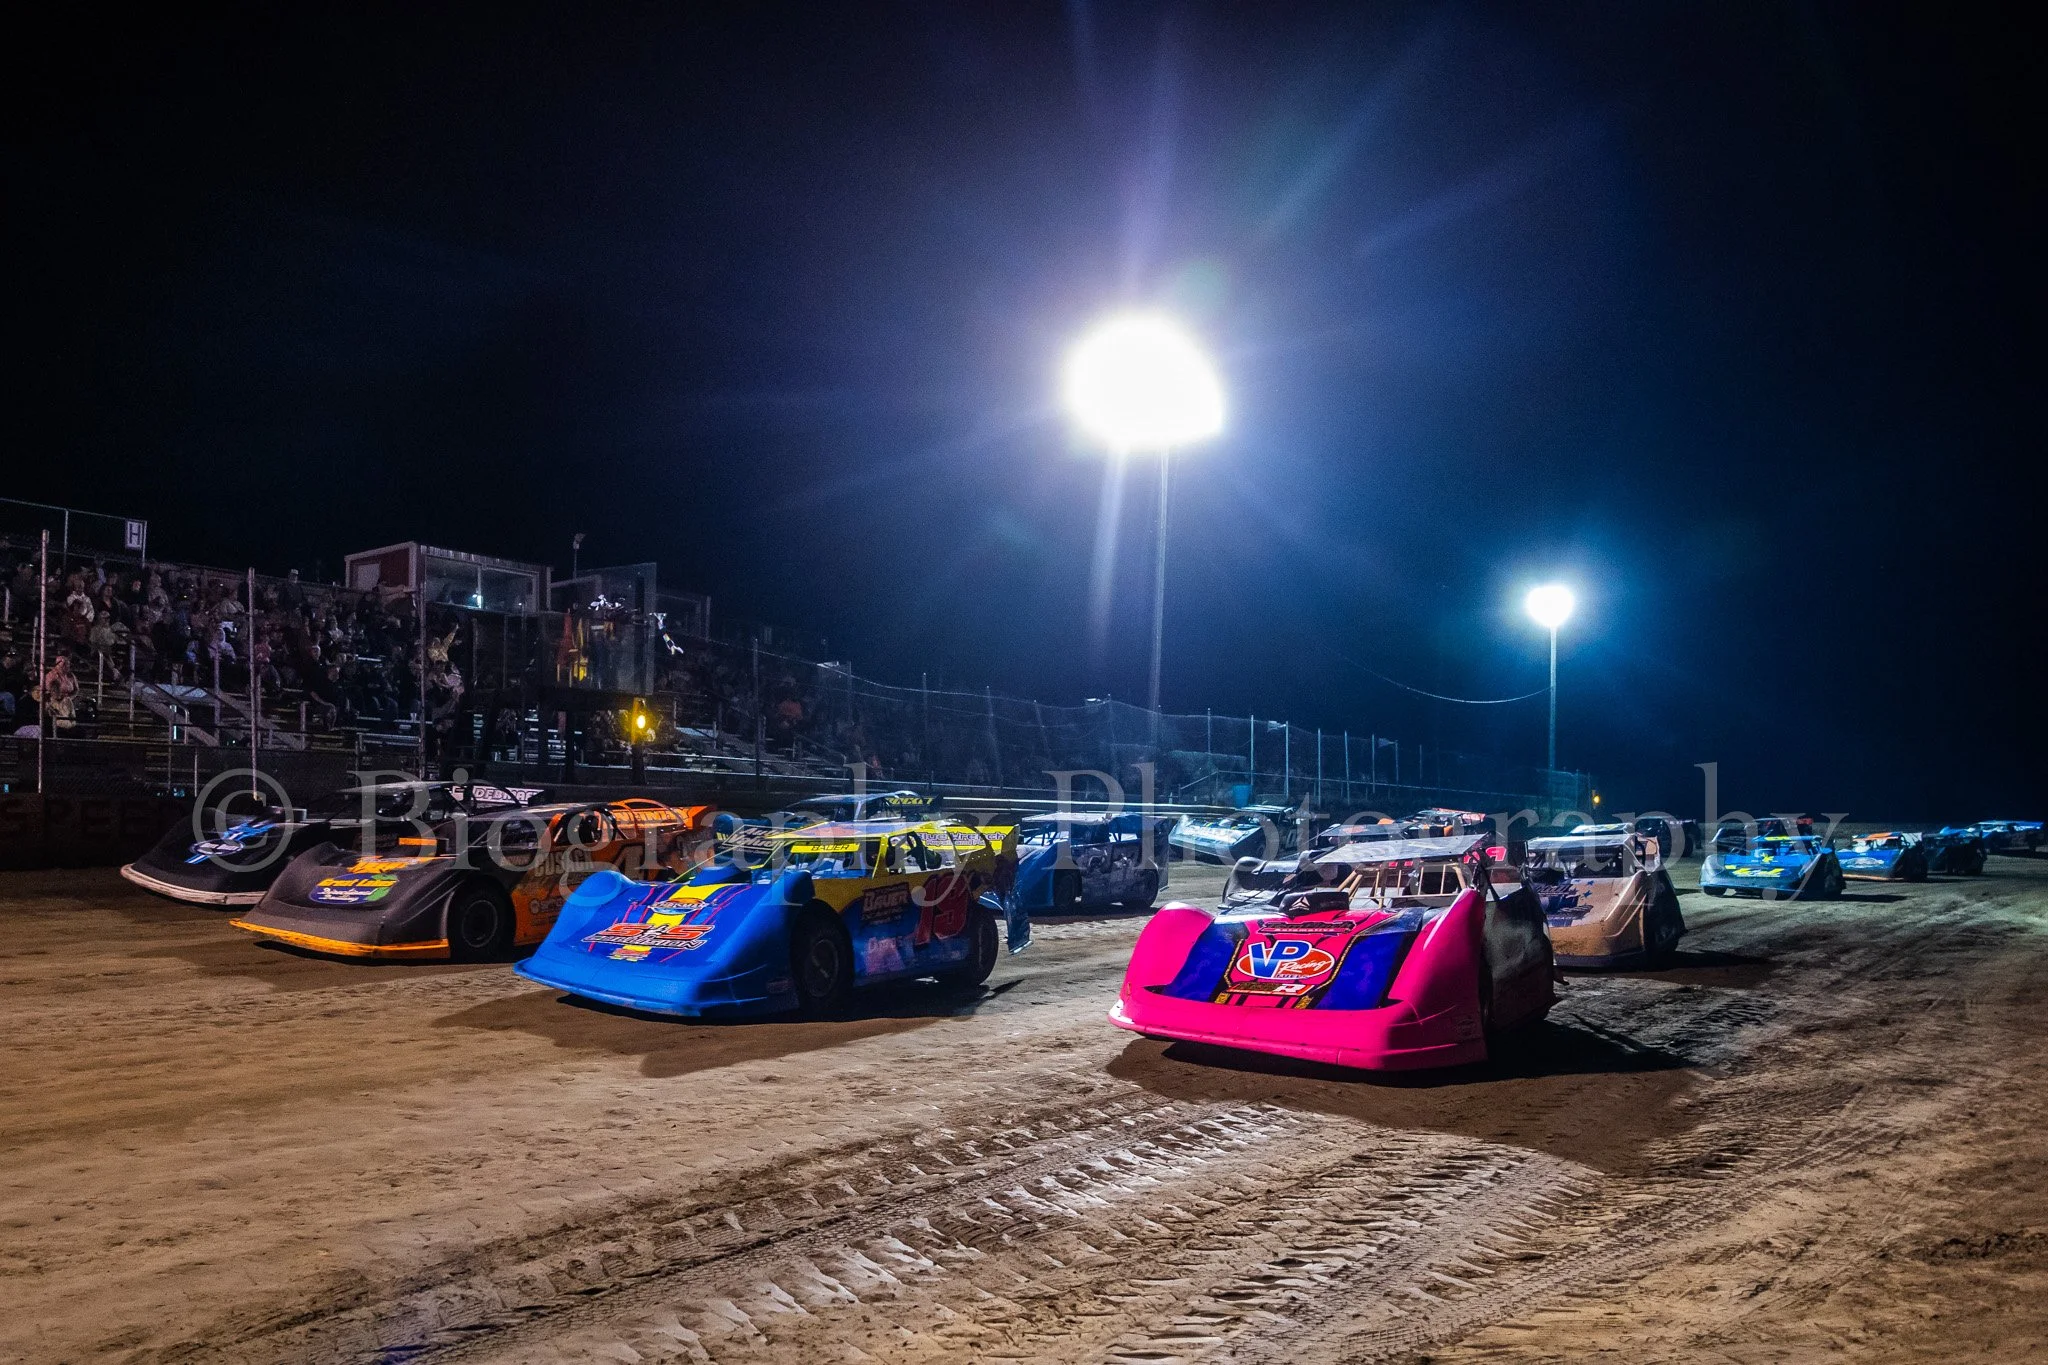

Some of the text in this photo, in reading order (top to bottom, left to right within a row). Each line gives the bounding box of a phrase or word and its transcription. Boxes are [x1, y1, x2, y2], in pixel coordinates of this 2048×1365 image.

[129, 523, 141, 546] H
[1247, 940, 1313, 978] VP
[1281, 959, 1333, 973] Racing
